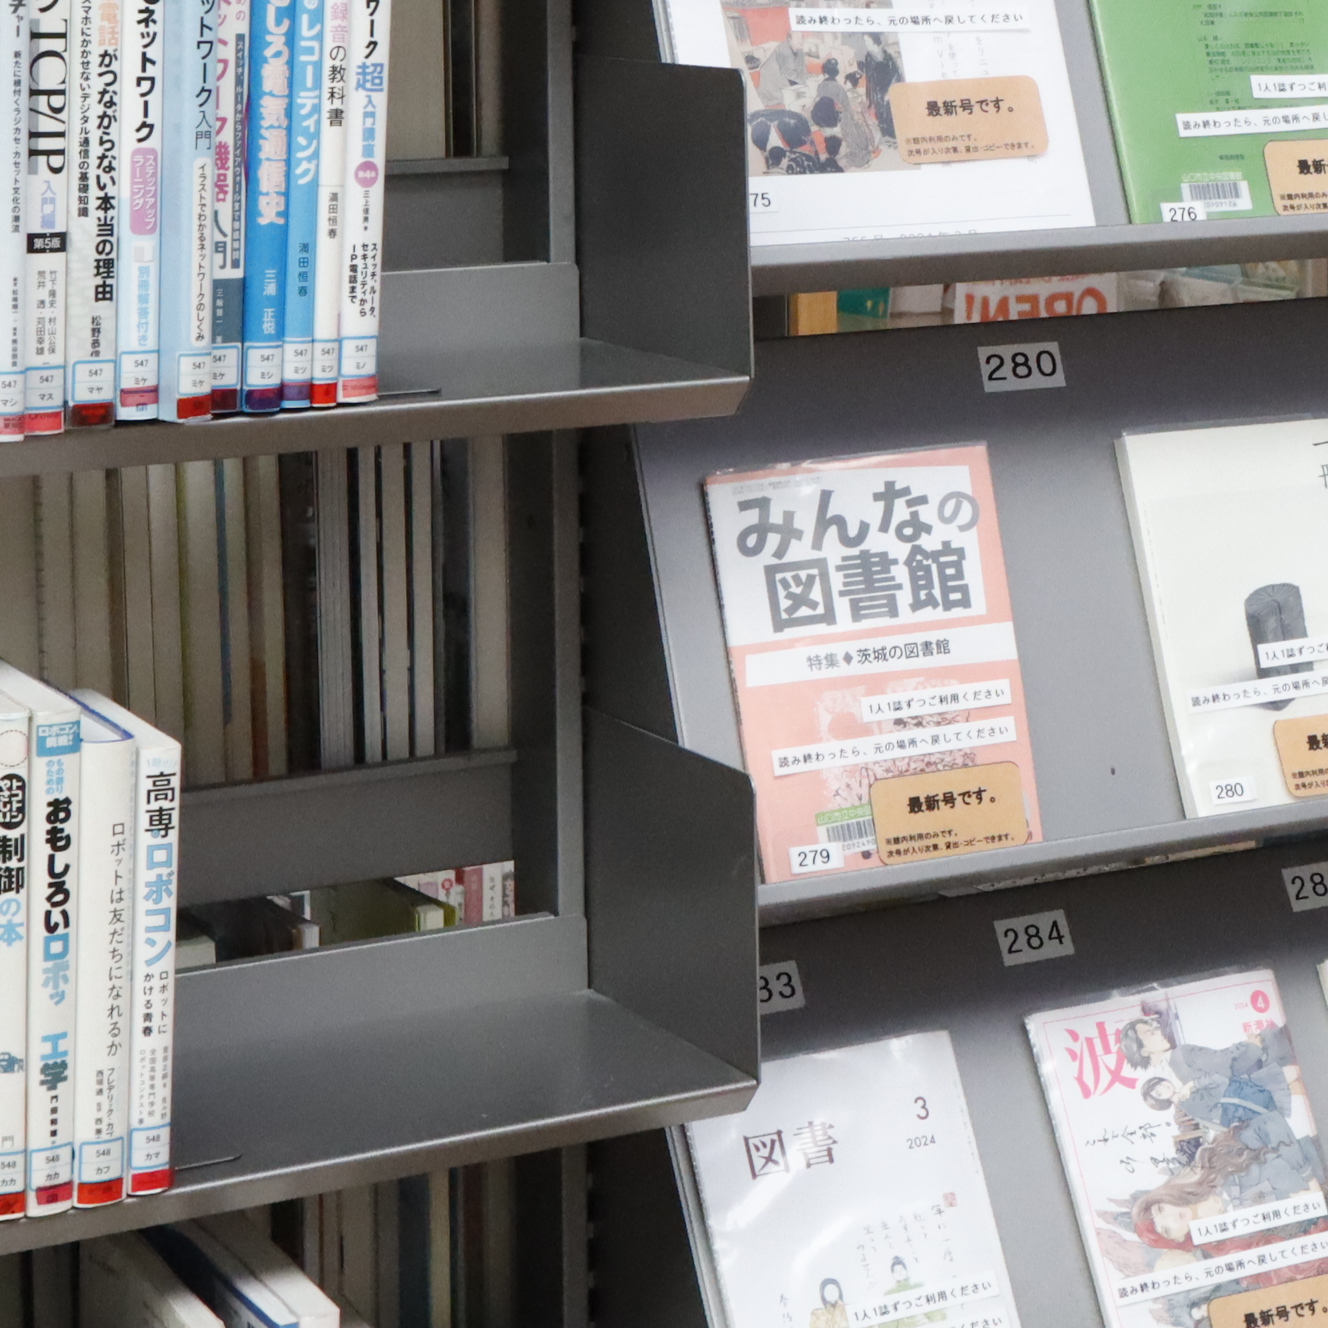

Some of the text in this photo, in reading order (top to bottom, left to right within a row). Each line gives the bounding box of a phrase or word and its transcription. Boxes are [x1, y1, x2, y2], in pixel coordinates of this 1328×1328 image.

[795, 12, 1024, 27] 読み終わったら、元の場所へ戻してください
[926, 96, 1016, 118] 最新号です。
[134, 155, 145, 211] ラーニング
[145, 155, 156, 231] ステップアップ
[327, 193, 338, 239] 満田恒春
[750, 192, 772, 209] 75
[1169, 206, 1197, 221] 276
[33, 237, 61, 250] 第5版
[195, 163, 207, 343] イラストでわかるネットワークのしくみ
[298, 243, 309, 297] 満田恒春
[985, 350, 1057, 382] 280
[736, 480, 980, 561] みんなの
[763, 540, 972, 634] 図書館
[856, 639, 951, 664] 茨城の図書館
[869, 688, 1005, 715] 1人1誌ずつご利用ください
[778, 726, 1009, 768] 読み終わったら、元の場所へ戻してください
[908, 787, 997, 815] 最新号です。
[1215, 783, 1243, 800] 280
[143, 771, 177, 967] 高専ロボコン
[798, 849, 830, 867] 279
[106, 823, 125, 1057] ロボットは友だちになれるか
[1003, 920, 1065, 955] 284
[158, 971, 168, 1035] ロボットに
[760, 972, 796, 1003] 83
[143, 973, 153, 1037] かける青春
[1064, 1021, 1139, 1100] 波
[914, 1096, 930, 1120] 3
[96, 1149, 110, 1157] 548
[146, 1134, 160, 1143] 548
[742, 1120, 838, 1180] 図書
[906, 1134, 936, 1150] 2024
[46, 1155, 59, 1163] 548
[1197, 1201, 1322, 1237] 1人1誌ずつご利用ください
[854, 1280, 992, 1322] 1人1誌ずつご利用ください
[1244, 1298, 1328, 1328] 最新号です。
